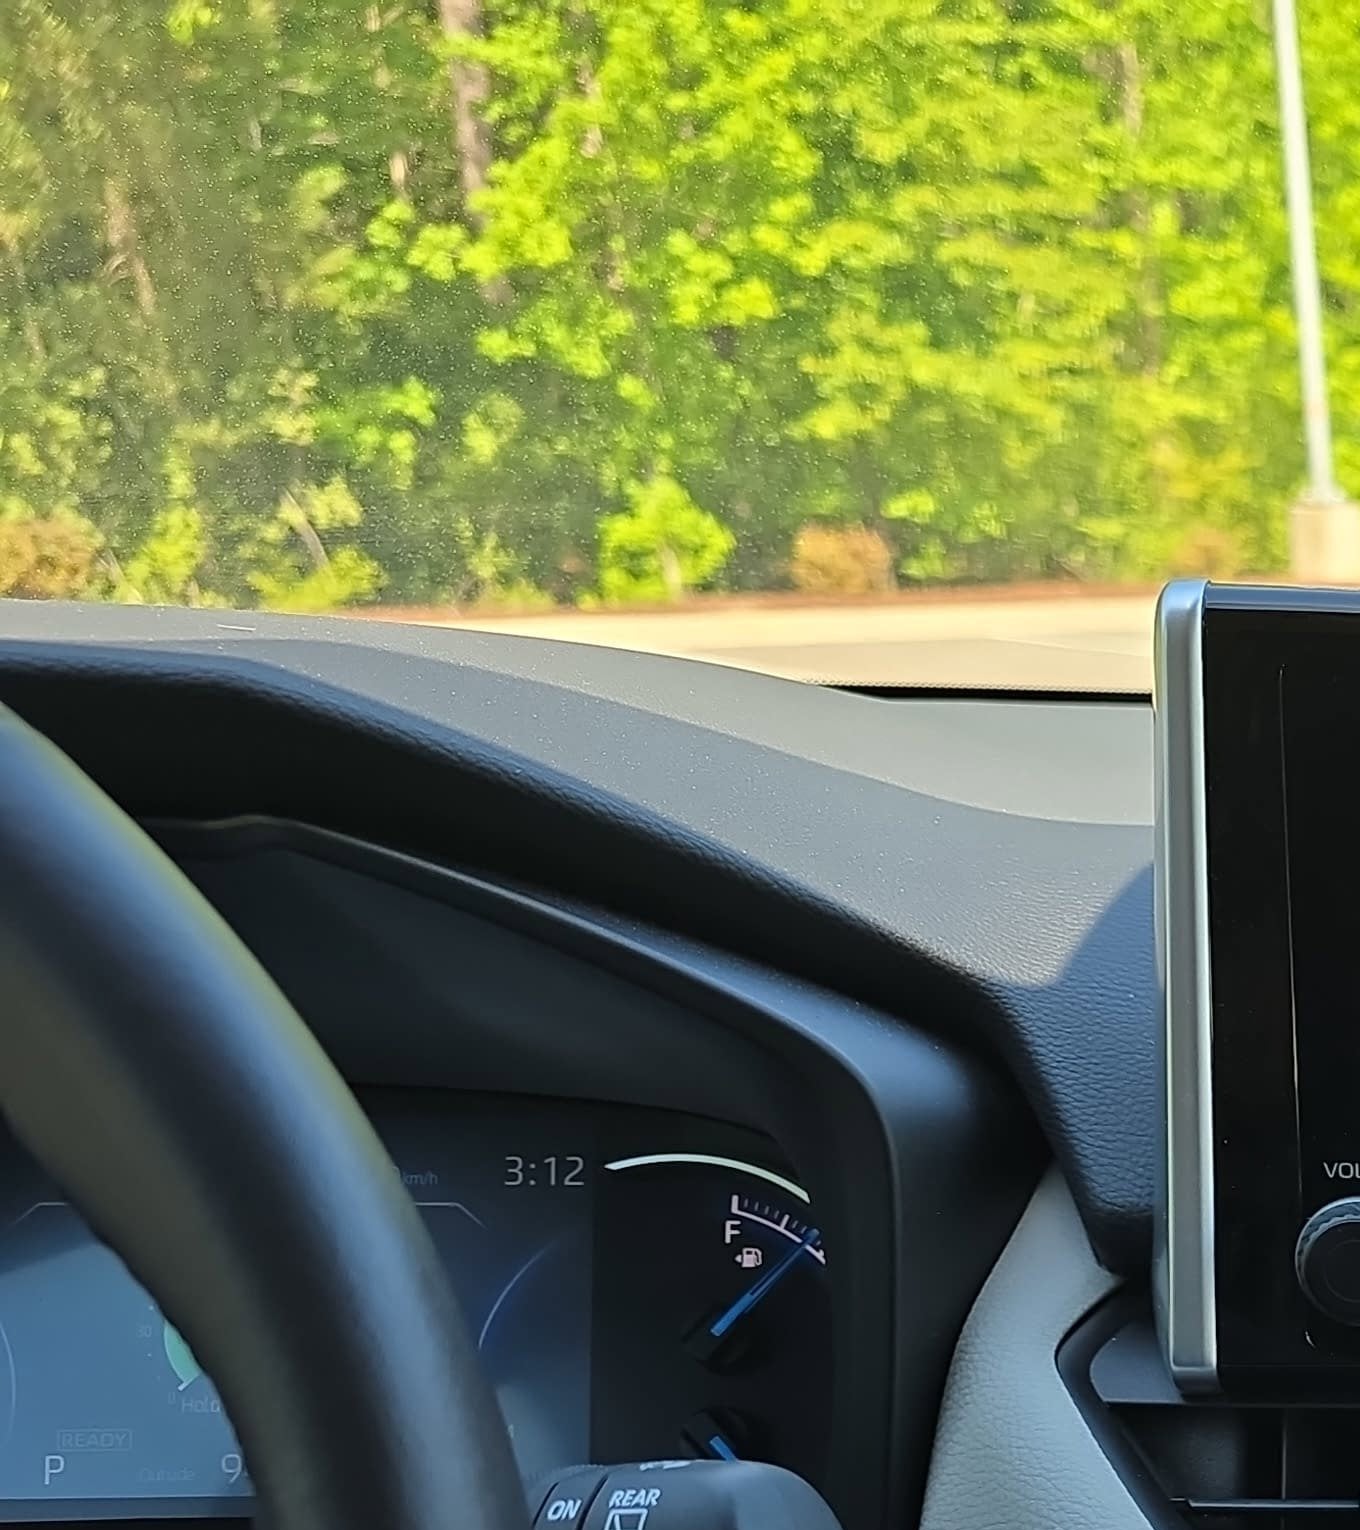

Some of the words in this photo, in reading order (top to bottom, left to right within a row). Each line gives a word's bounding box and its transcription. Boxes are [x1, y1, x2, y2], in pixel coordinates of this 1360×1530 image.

[503, 1155, 585, 1188] 3:12
[724, 1219, 742, 1244] F
[60, 1431, 128, 1449] READY
[44, 1454, 65, 1486] P
[221, 1453, 250, 1484] 9
[547, 1499, 581, 1521] ON
[608, 1488, 661, 1508] REAR
